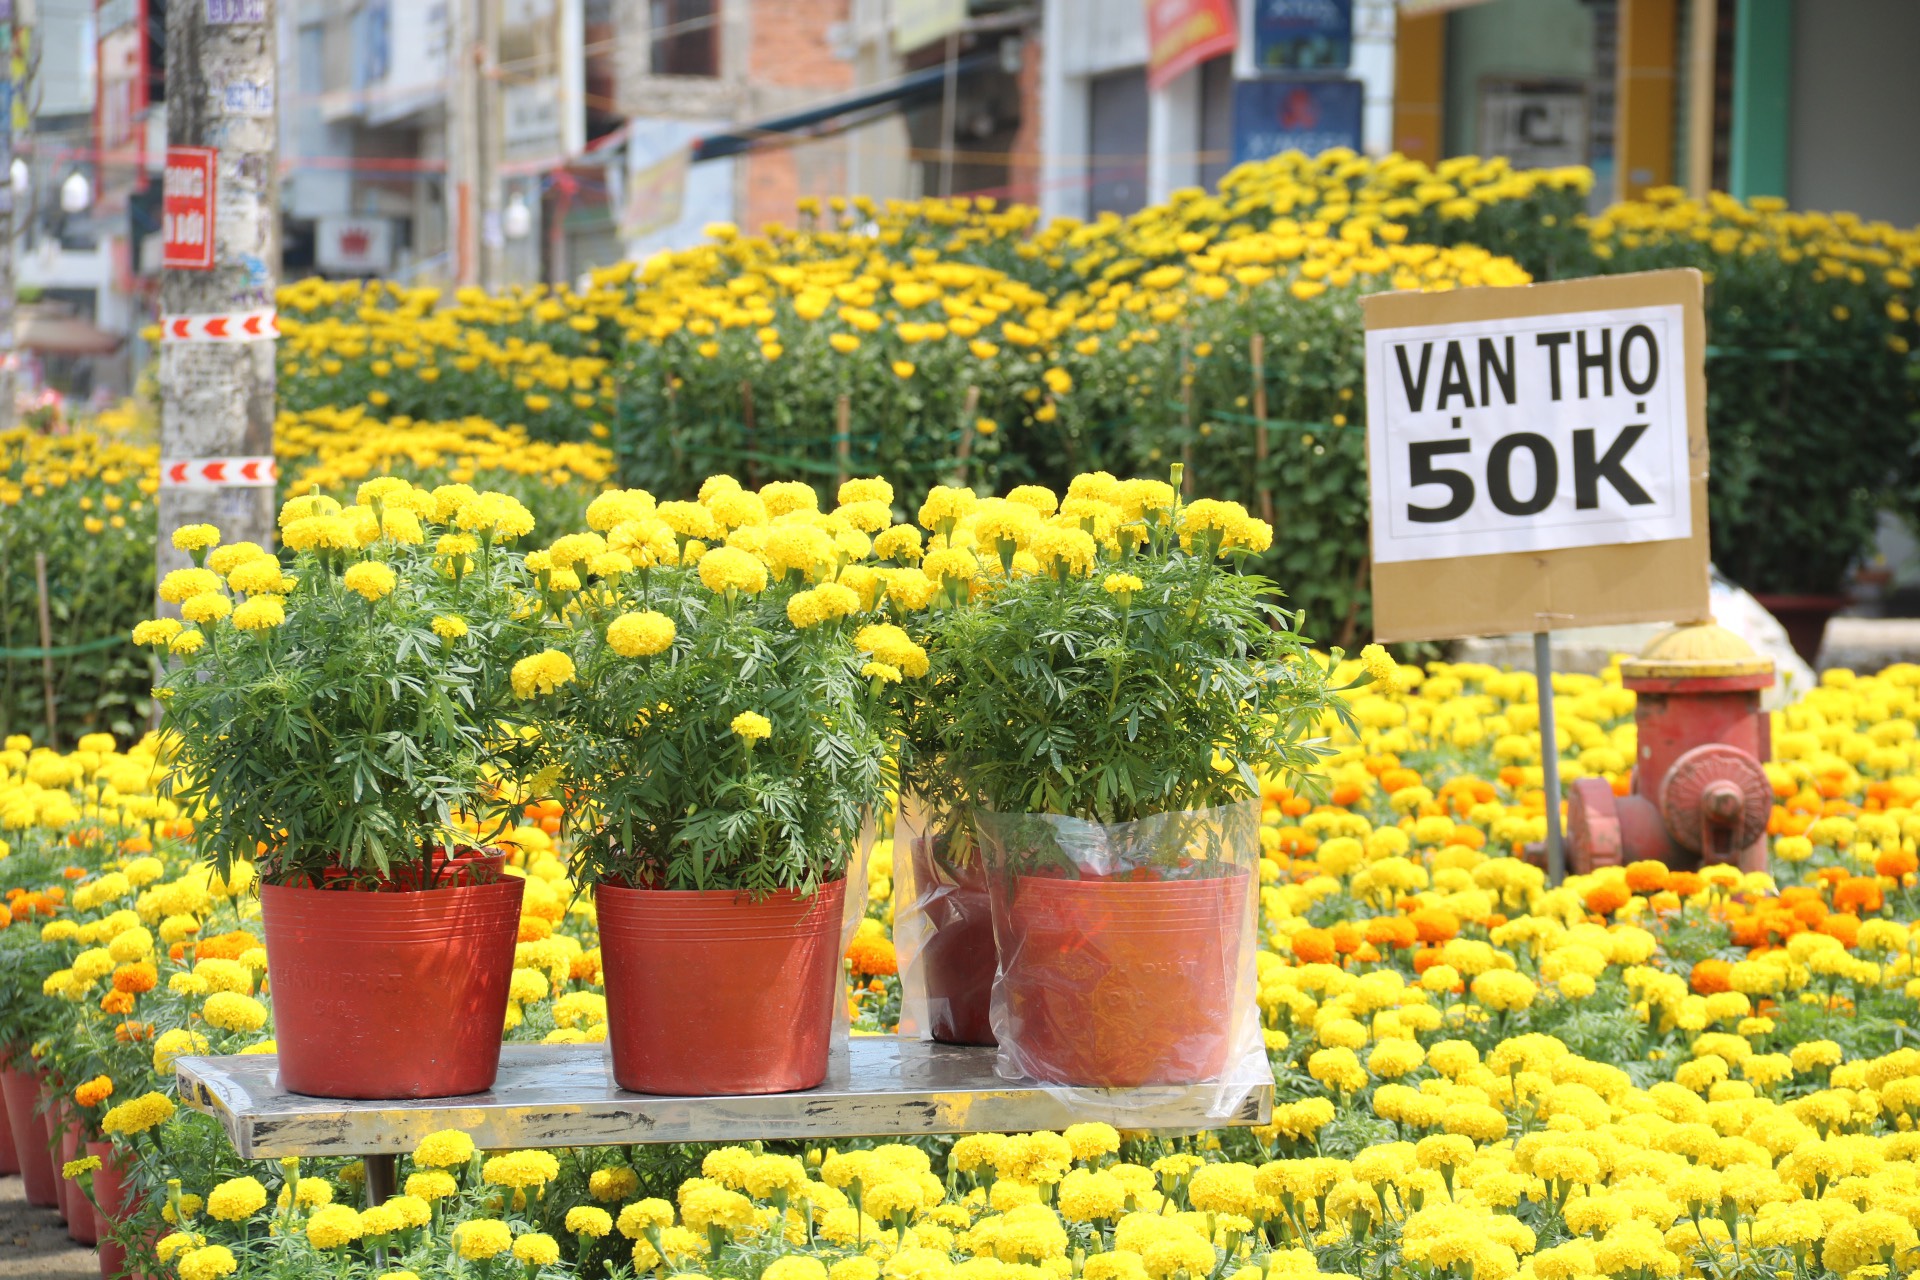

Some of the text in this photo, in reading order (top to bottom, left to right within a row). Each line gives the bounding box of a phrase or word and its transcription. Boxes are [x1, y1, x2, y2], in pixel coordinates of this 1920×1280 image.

[1394, 323, 1660, 430] VẠN THỌ
[1407, 423, 1657, 524] 50K
